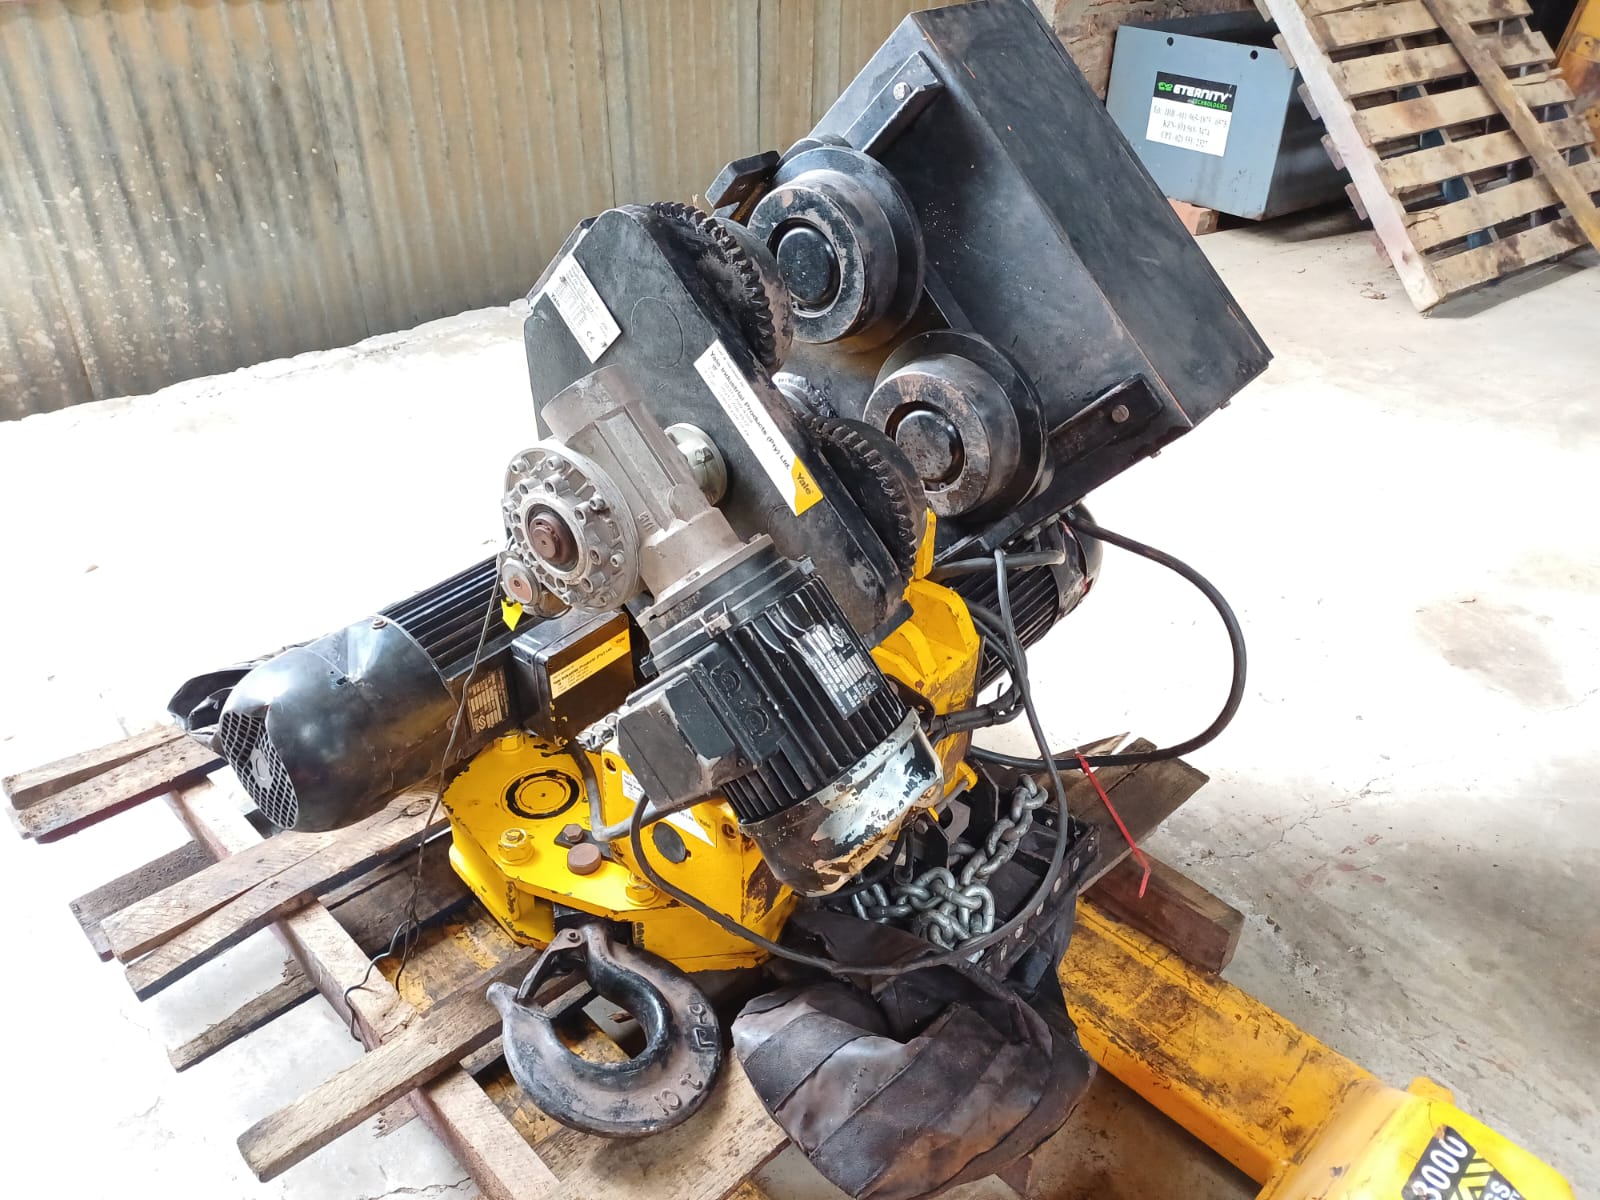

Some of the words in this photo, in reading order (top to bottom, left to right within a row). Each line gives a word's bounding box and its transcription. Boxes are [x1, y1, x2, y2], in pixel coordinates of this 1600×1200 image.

[1173, 84, 1228, 103] ETERNITY
[710, 350, 721, 371] Yale
[720, 367, 746, 402] Industrial
[743, 401, 769, 437] Products
[766, 431, 781, 456] (Pty)
[796, 471, 814, 496] Yale
